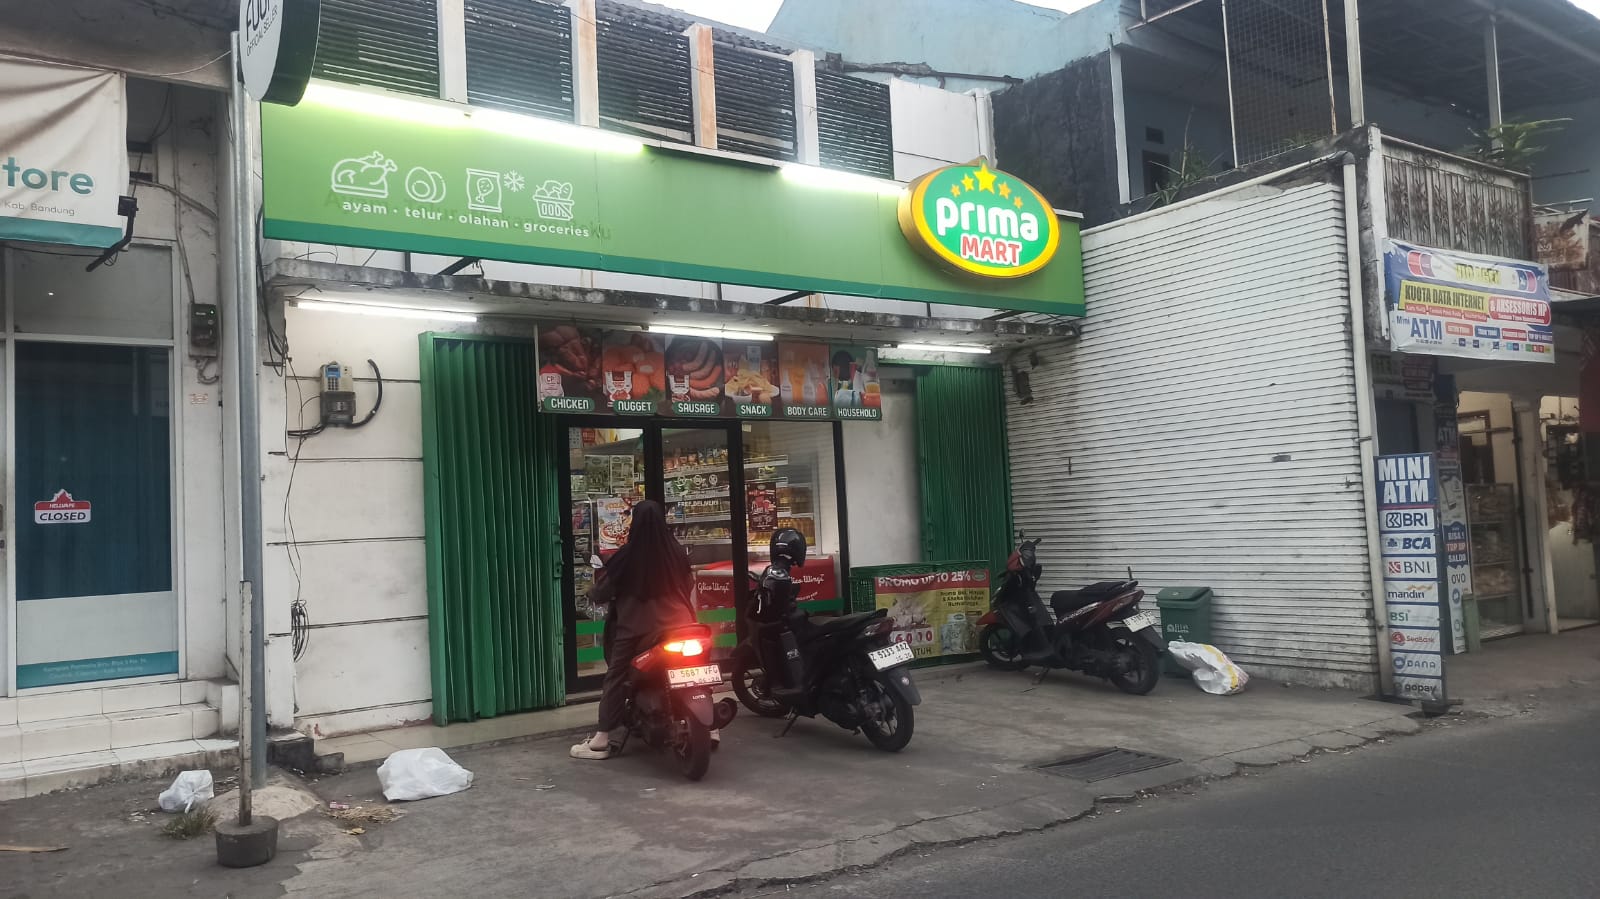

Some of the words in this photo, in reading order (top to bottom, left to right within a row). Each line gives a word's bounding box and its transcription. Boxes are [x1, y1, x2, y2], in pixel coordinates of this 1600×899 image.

[246, 0, 270, 42] FOO
[30, 202, 75, 217] Bandung
[342, 201, 387, 214] ayam
[405, 207, 442, 221] telur
[458, 214, 509, 229] olahan
[523, 222, 590, 237] groceries
[935, 196, 1039, 242] prima
[961, 234, 1021, 265] MART
[1405, 284, 1432, 303] KUOTA
[1433, 288, 1452, 306] DATA
[1452, 292, 1485, 311] INTERNET
[1538, 303, 1547, 317] HP
[1410, 318, 1442, 340] ATM
[551, 398, 589, 410] CHICKEN
[618, 401, 652, 412] NUGGET
[678, 403, 716, 414] SAUSAGE
[740, 404, 767, 415] SNACK
[787, 406, 807, 416] BODY
[808, 406, 828, 417] CARE
[837, 407, 877, 418] HOUSEHOLD
[1378, 455, 1431, 481] MINI
[1383, 480, 1429, 503] ATM
[39, 511, 86, 521] CLOSED
[1403, 512, 1428, 527] BRI
[1402, 537, 1431, 550] BCA
[1404, 561, 1431, 574] BNI
[878, 576, 919, 587] PROMO
[921, 575, 935, 585] UP
[936, 572, 949, 583] TO
[951, 570, 971, 582] 25%
[1451, 573, 1466, 584] OVO
[1387, 590, 1425, 599] mandiri
[1390, 612, 1409, 622] BSI
[1407, 661, 1436, 669] DANA
[1405, 683, 1436, 692] gopay
